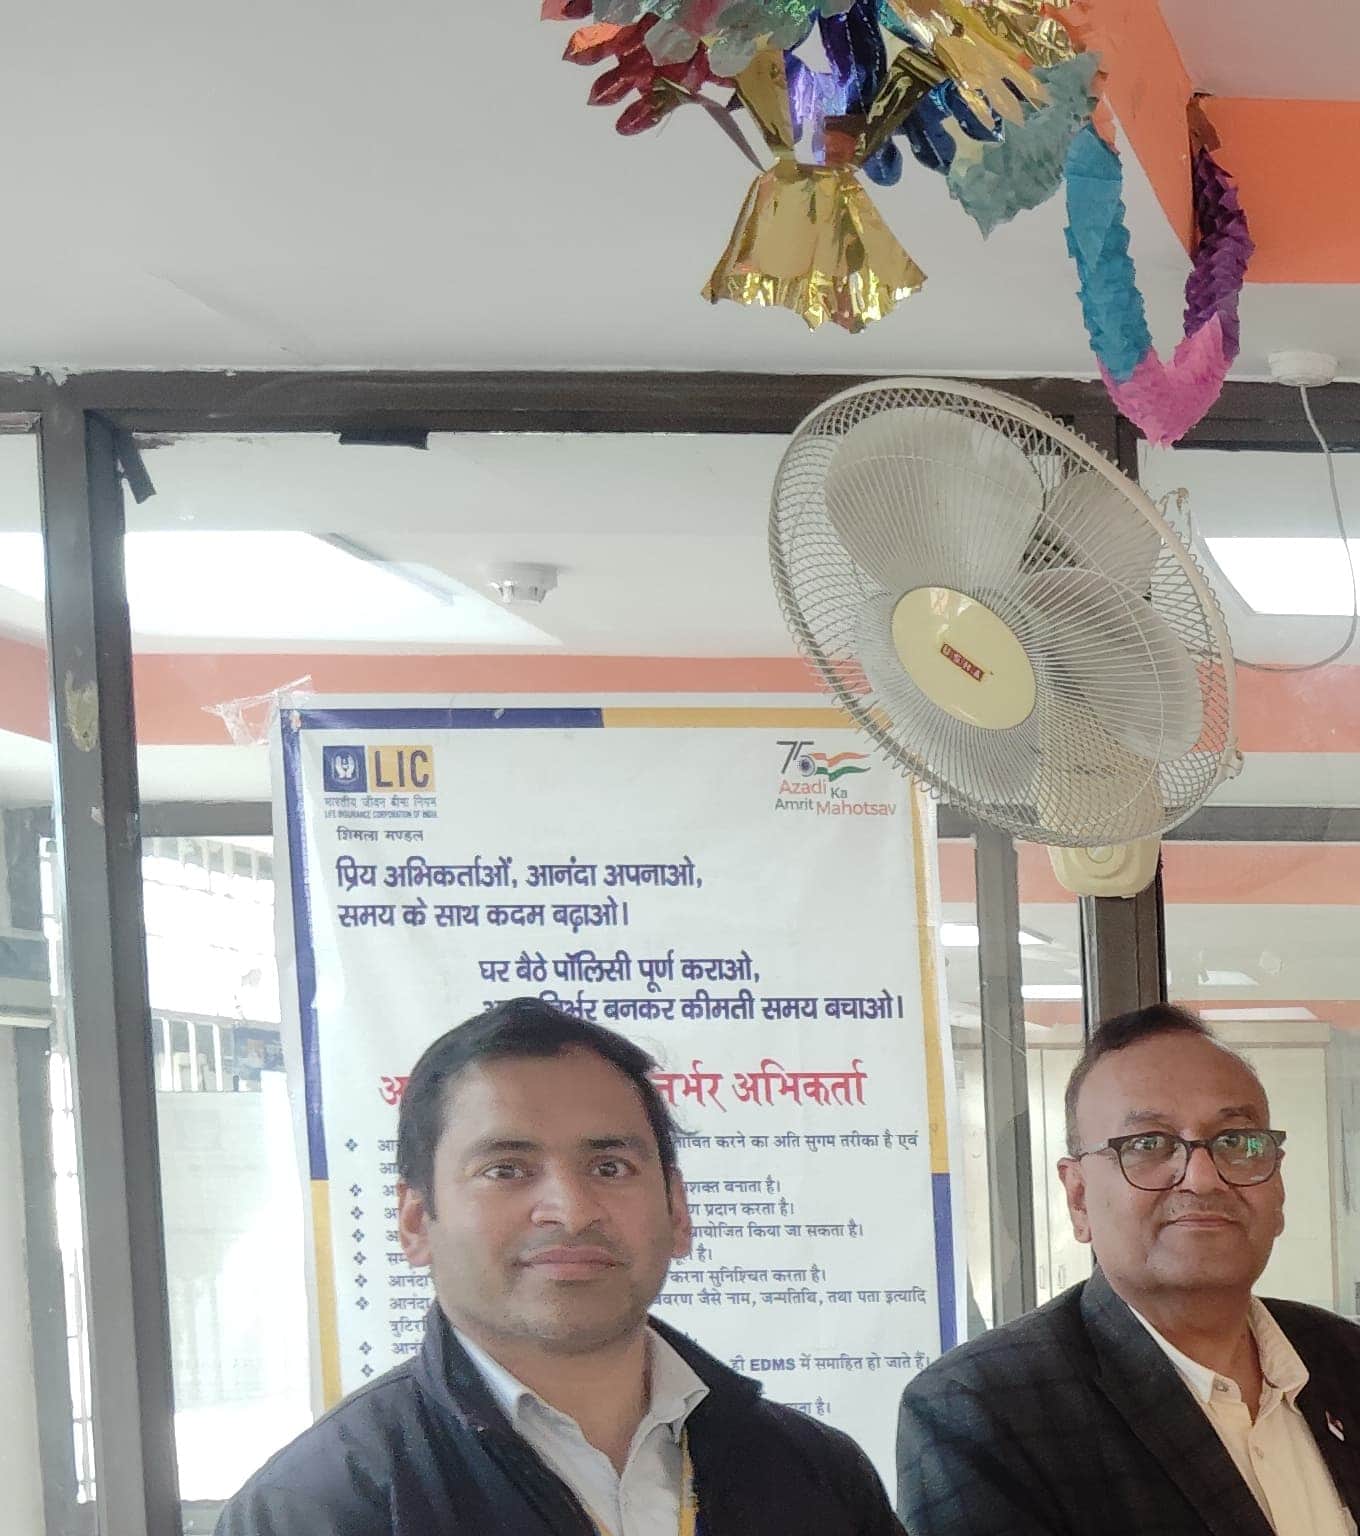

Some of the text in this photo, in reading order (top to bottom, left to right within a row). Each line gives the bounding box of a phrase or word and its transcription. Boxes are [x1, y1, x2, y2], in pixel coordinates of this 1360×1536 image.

[374, 750, 429, 788] LIC
[779, 779, 848, 799] Azadi Ka
[775, 798, 897, 816] Amrit Mahotsav
[336, 826, 424, 842] शिमला मण्डल
[336, 856, 703, 891] प्रिय अभिकर्ताओं, आनंदा अपनाओ,
[338, 904, 396, 927] समय
[402, 897, 428, 927] के
[434, 904, 479, 927] साथ
[487, 904, 545, 927] कदम
[479, 950, 760, 991] घर बैठे पॉलिसी पूर्ण कराओ,
[603, 998, 675, 1021] बनकर
[681, 989, 755, 1020] कीमती
[761, 997, 818, 1020] समय
[732, 1058, 868, 1107] अभिकर्ता
[716, 1131, 745, 1148] करने
[750, 1135, 768, 1148] का
[774, 1131, 800, 1148] अति
[840, 1131, 879, 1147] तरीका
[884, 1130, 894, 1148] है
[772, 1269, 806, 1283] करता
[750, 1360, 796, 1371] EDMS
[867, 1352, 881, 1369] हो
[884, 1352, 911, 1368] जाते
